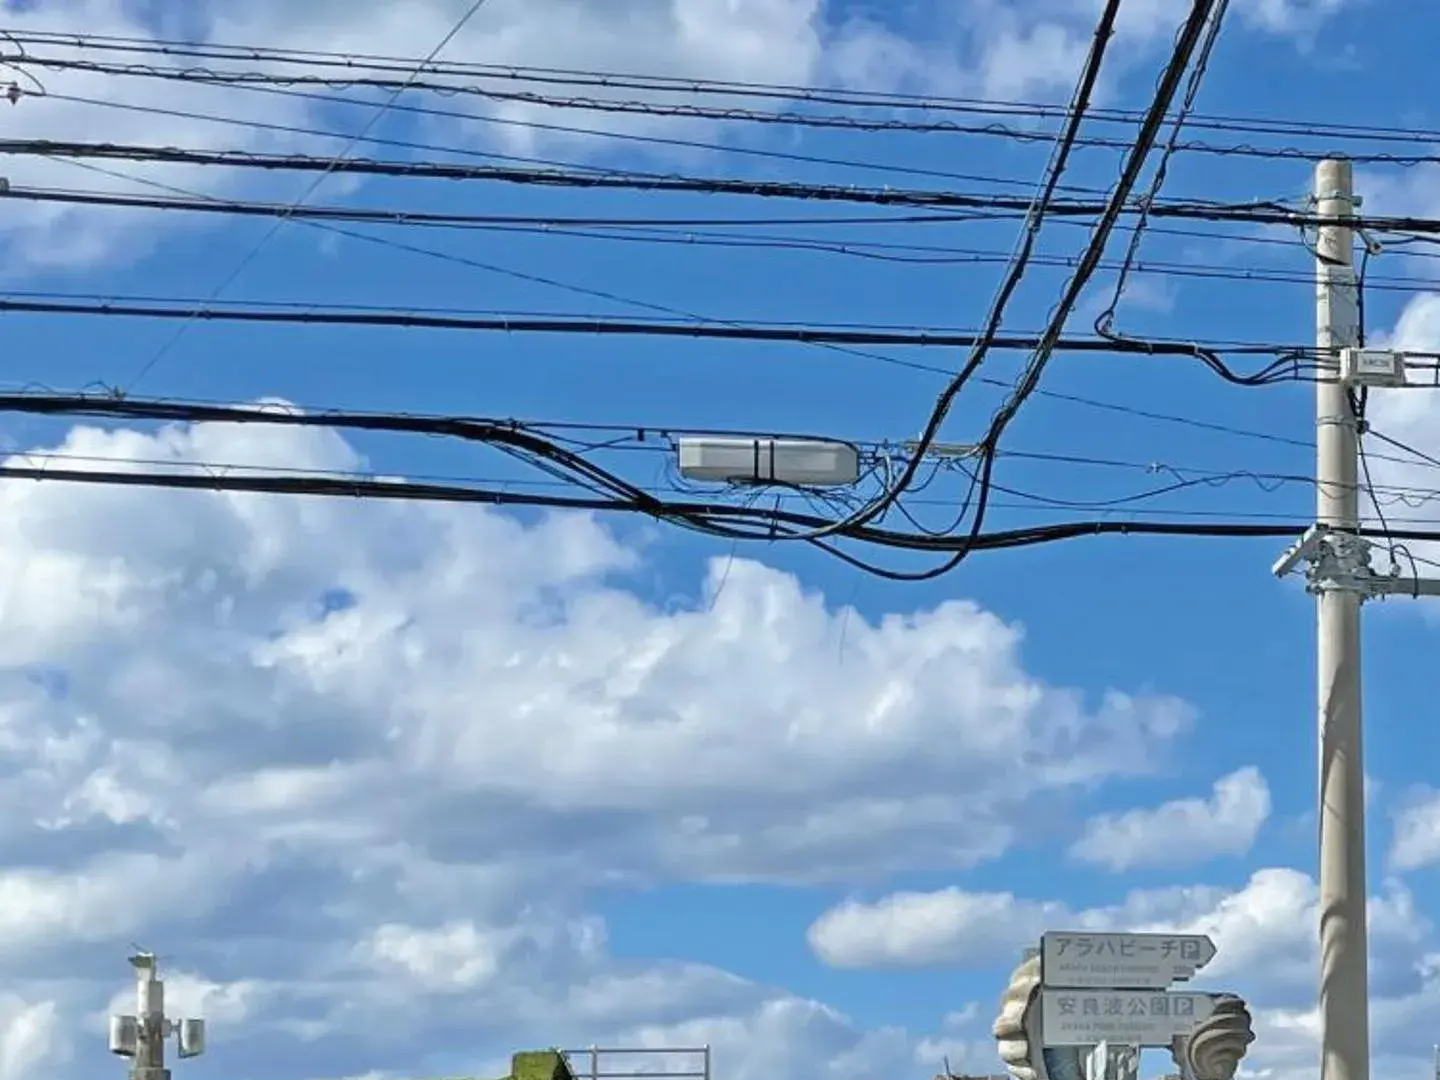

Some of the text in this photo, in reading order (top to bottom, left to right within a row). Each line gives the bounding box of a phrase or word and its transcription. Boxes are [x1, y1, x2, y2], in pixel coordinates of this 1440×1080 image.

[1057, 938, 1179, 958] アラハビーチ
